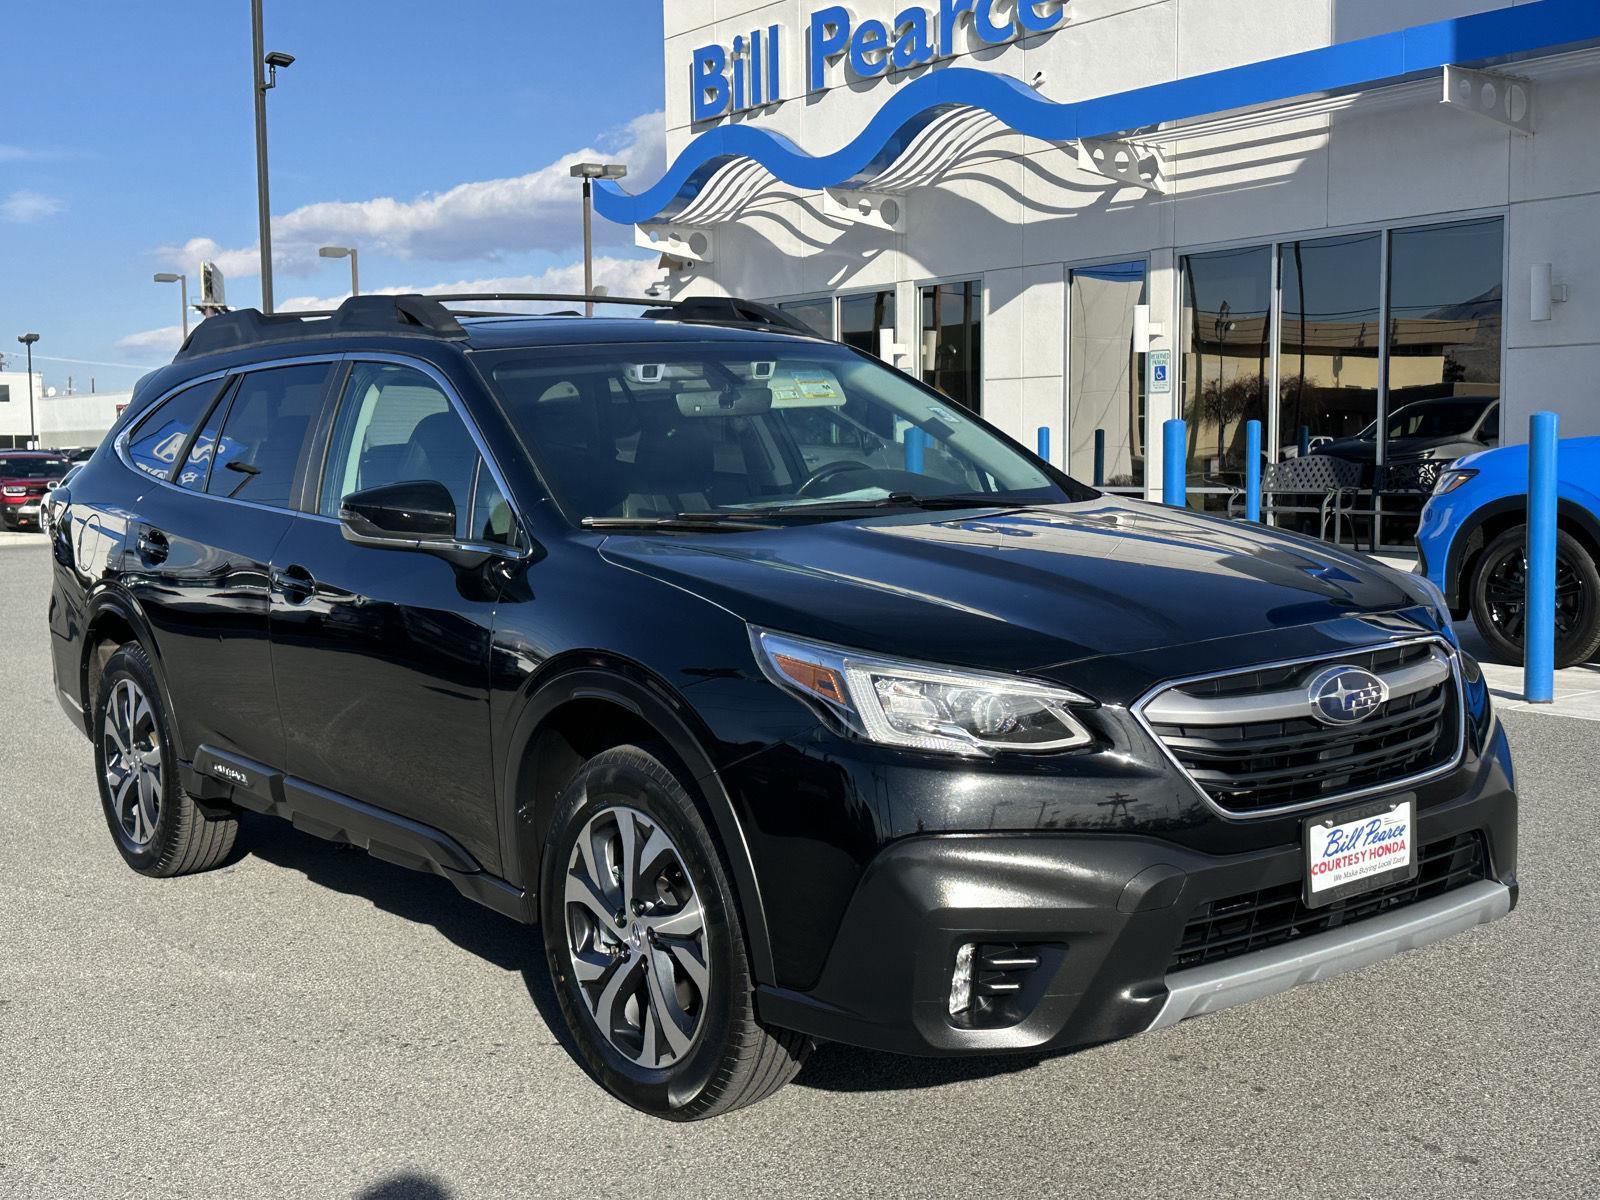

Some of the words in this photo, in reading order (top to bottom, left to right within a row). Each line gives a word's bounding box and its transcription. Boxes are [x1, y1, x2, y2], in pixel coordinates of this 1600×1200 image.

[693, 25, 780, 120] Bill
[810, 0, 1064, 91] Pearce
[1323, 826, 1364, 857] Bill
[1363, 819, 1406, 847] Pearce
[1311, 850, 1367, 875] COURTESY
[1369, 840, 1406, 860] HONDA
[1343, 868, 1358, 878] Make
[1359, 864, 1377, 875] Buying
